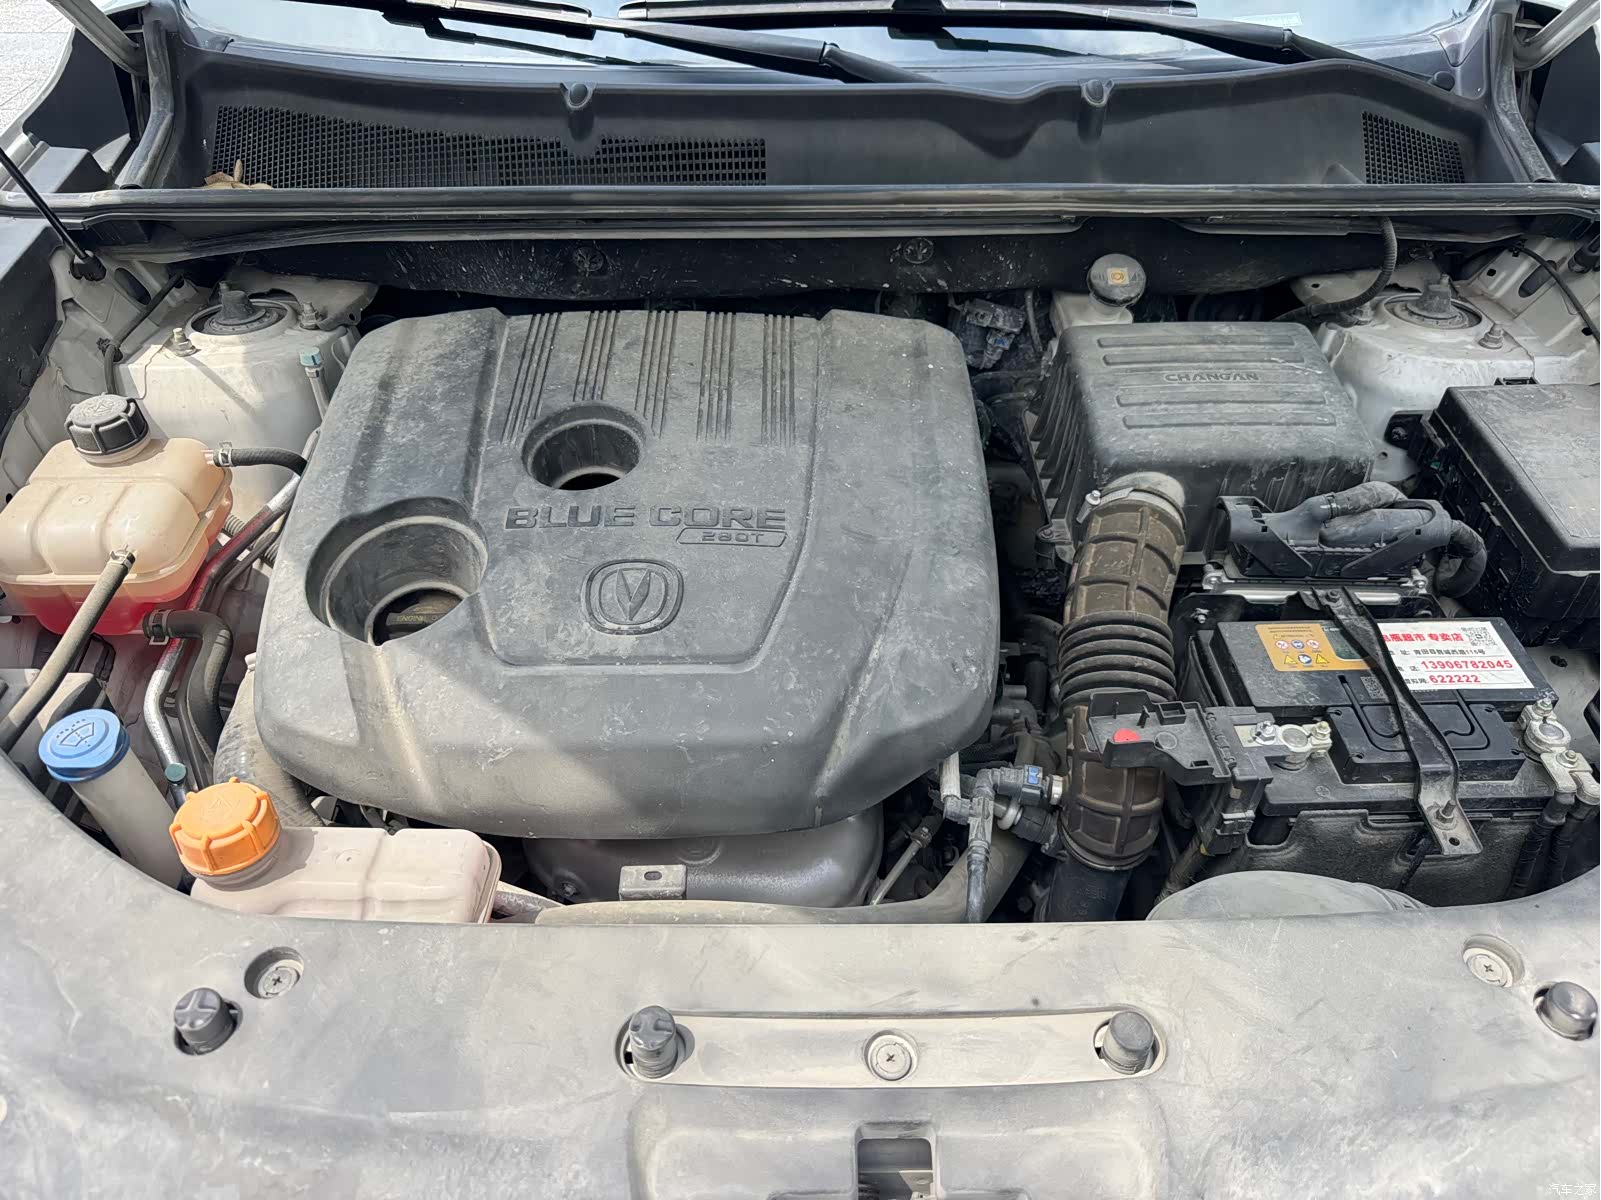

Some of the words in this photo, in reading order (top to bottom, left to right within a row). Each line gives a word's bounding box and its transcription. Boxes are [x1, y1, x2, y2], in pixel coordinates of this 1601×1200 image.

[1165, 373, 1259, 382] CHANGAN
[504, 505, 636, 530] BLUE
[650, 505, 786, 529] CORE
[701, 531, 765, 544] 280T
[1421, 660, 1513, 669] 13906782045
[1429, 674, 1481, 684] 622222
